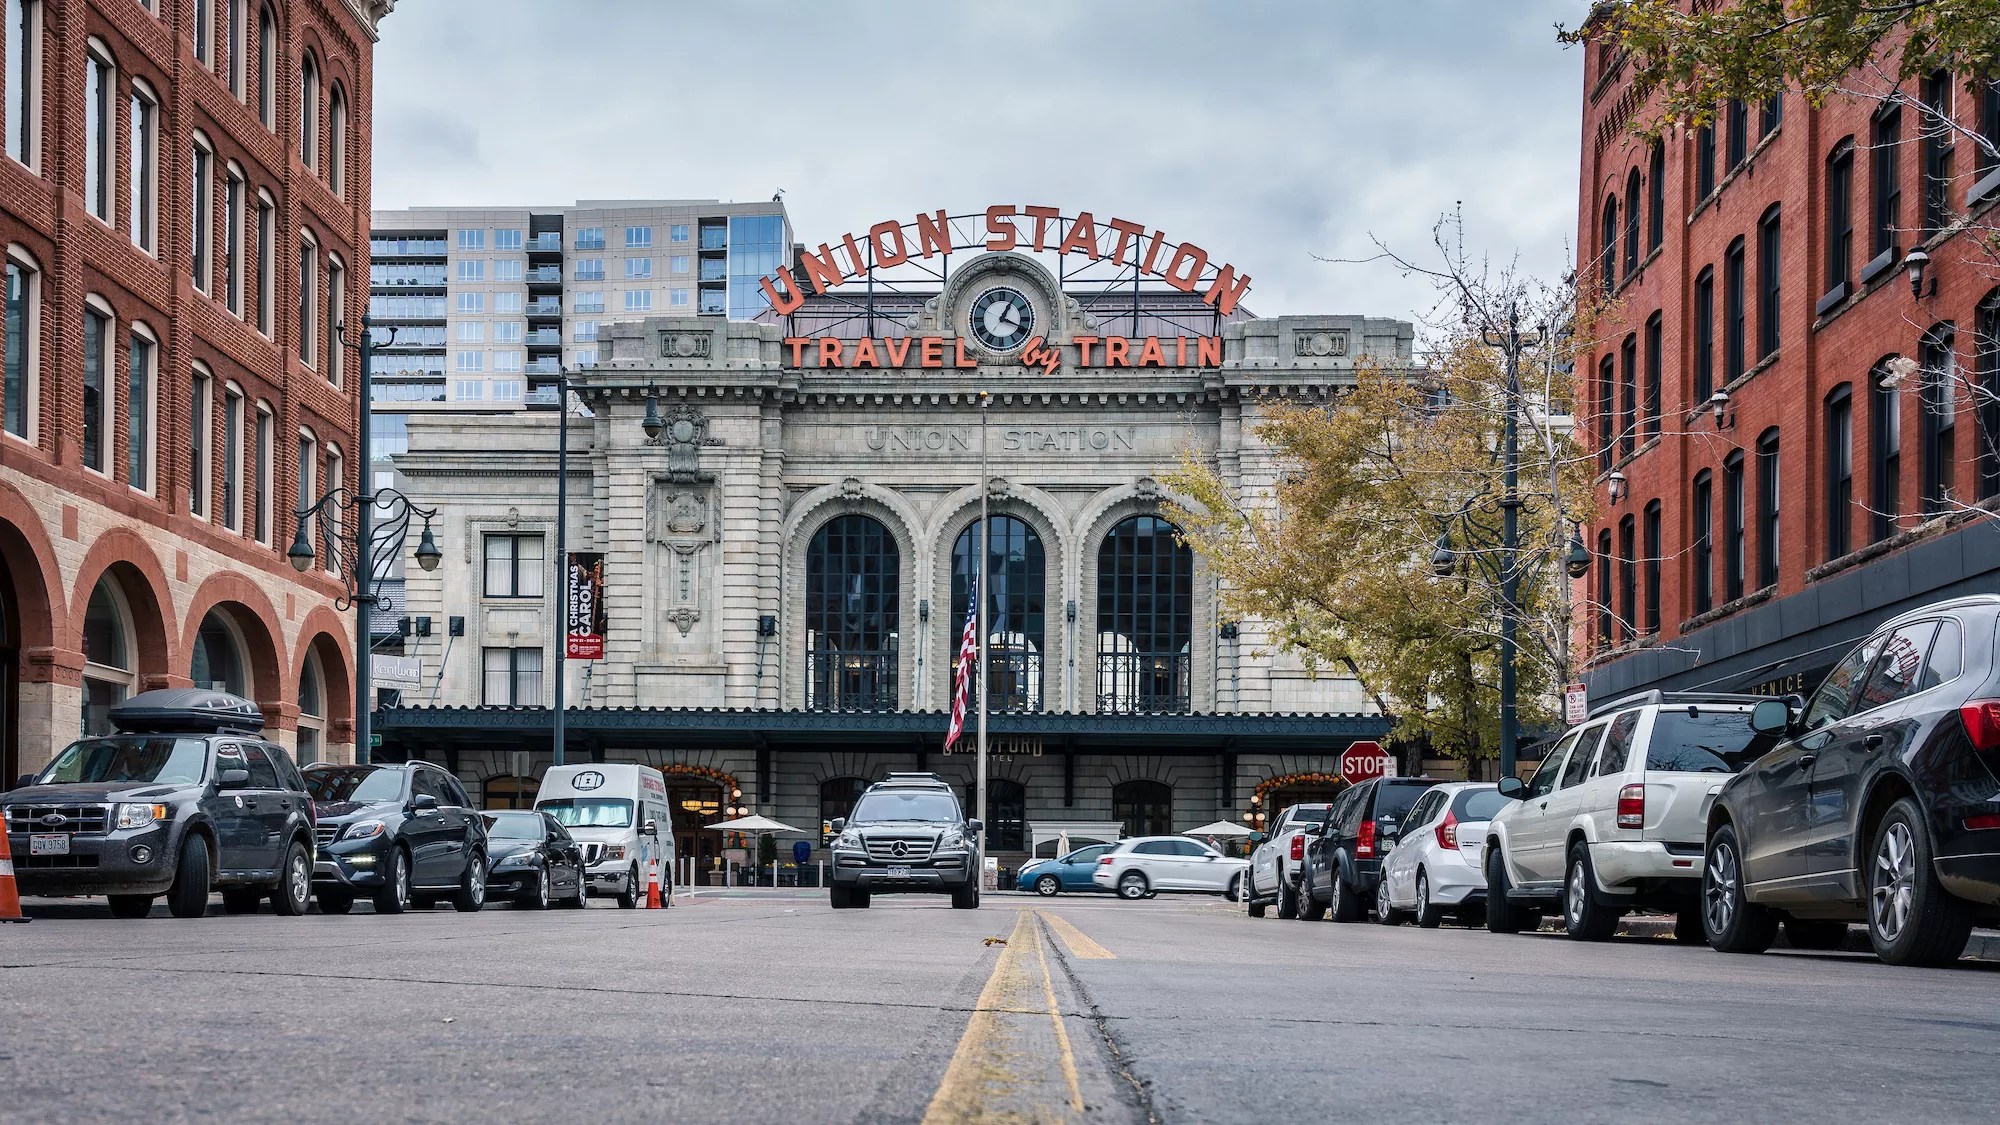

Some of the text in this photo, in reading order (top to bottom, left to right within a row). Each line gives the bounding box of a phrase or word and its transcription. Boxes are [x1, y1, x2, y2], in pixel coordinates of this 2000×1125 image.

[759, 204, 1252, 318] UNION STATION
[784, 335, 1222, 376] TRAVEL by TRAIN
[865, 430, 1135, 451] UNION STATION
[570, 565, 578, 637] A CHRISTMAS
[579, 580, 592, 637] CAROL
[1751, 672, 1803, 697] VENICE
[1345, 756, 1385, 774] STOP
[48, 839, 66, 850] 9758
